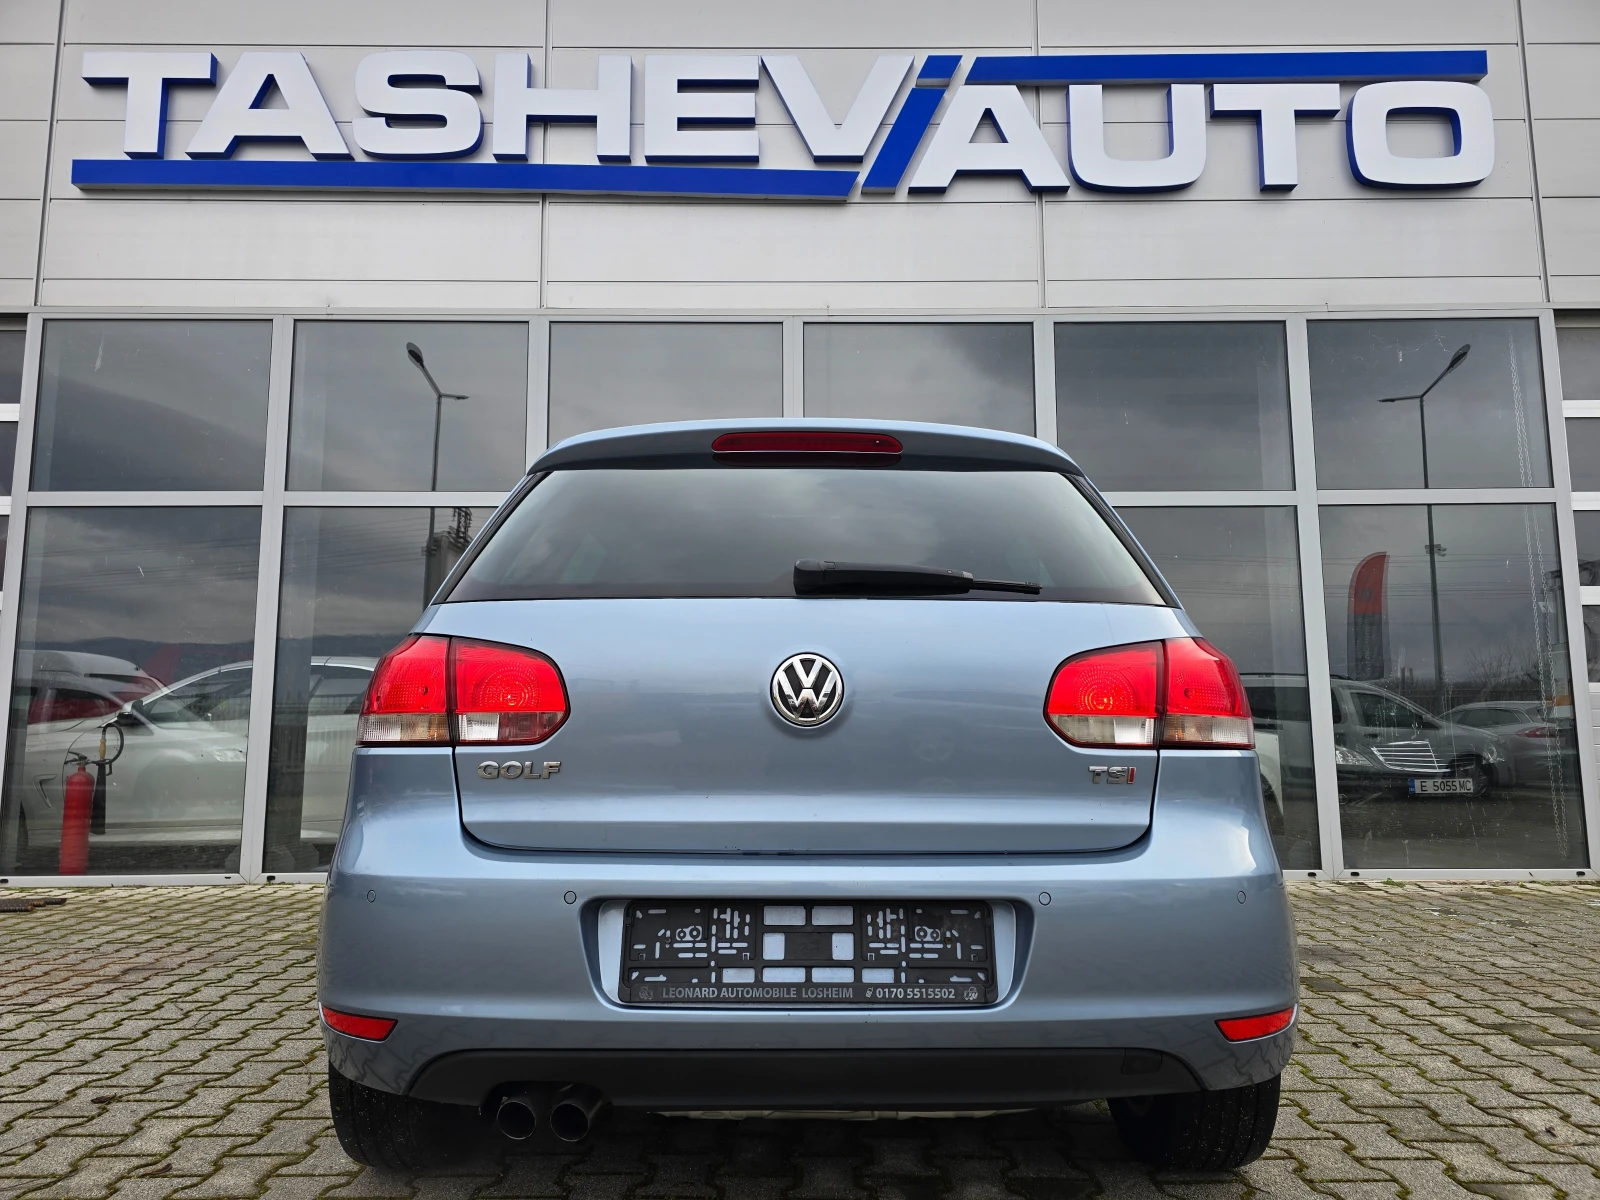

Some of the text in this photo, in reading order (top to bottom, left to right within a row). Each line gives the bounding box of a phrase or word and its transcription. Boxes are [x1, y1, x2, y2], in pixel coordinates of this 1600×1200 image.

[82, 50, 1495, 191] TASHEV AUTO
[477, 760, 562, 779] GOLF
[1088, 765, 1137, 784] TSI
[1420, 780, 1428, 792] E
[1432, 780, 1458, 792] 5055
[1458, 779, 1472, 791] MC
[662, 987, 956, 999] LEONARD AUTOMOBILE LOSHEIM 0170 5515502
